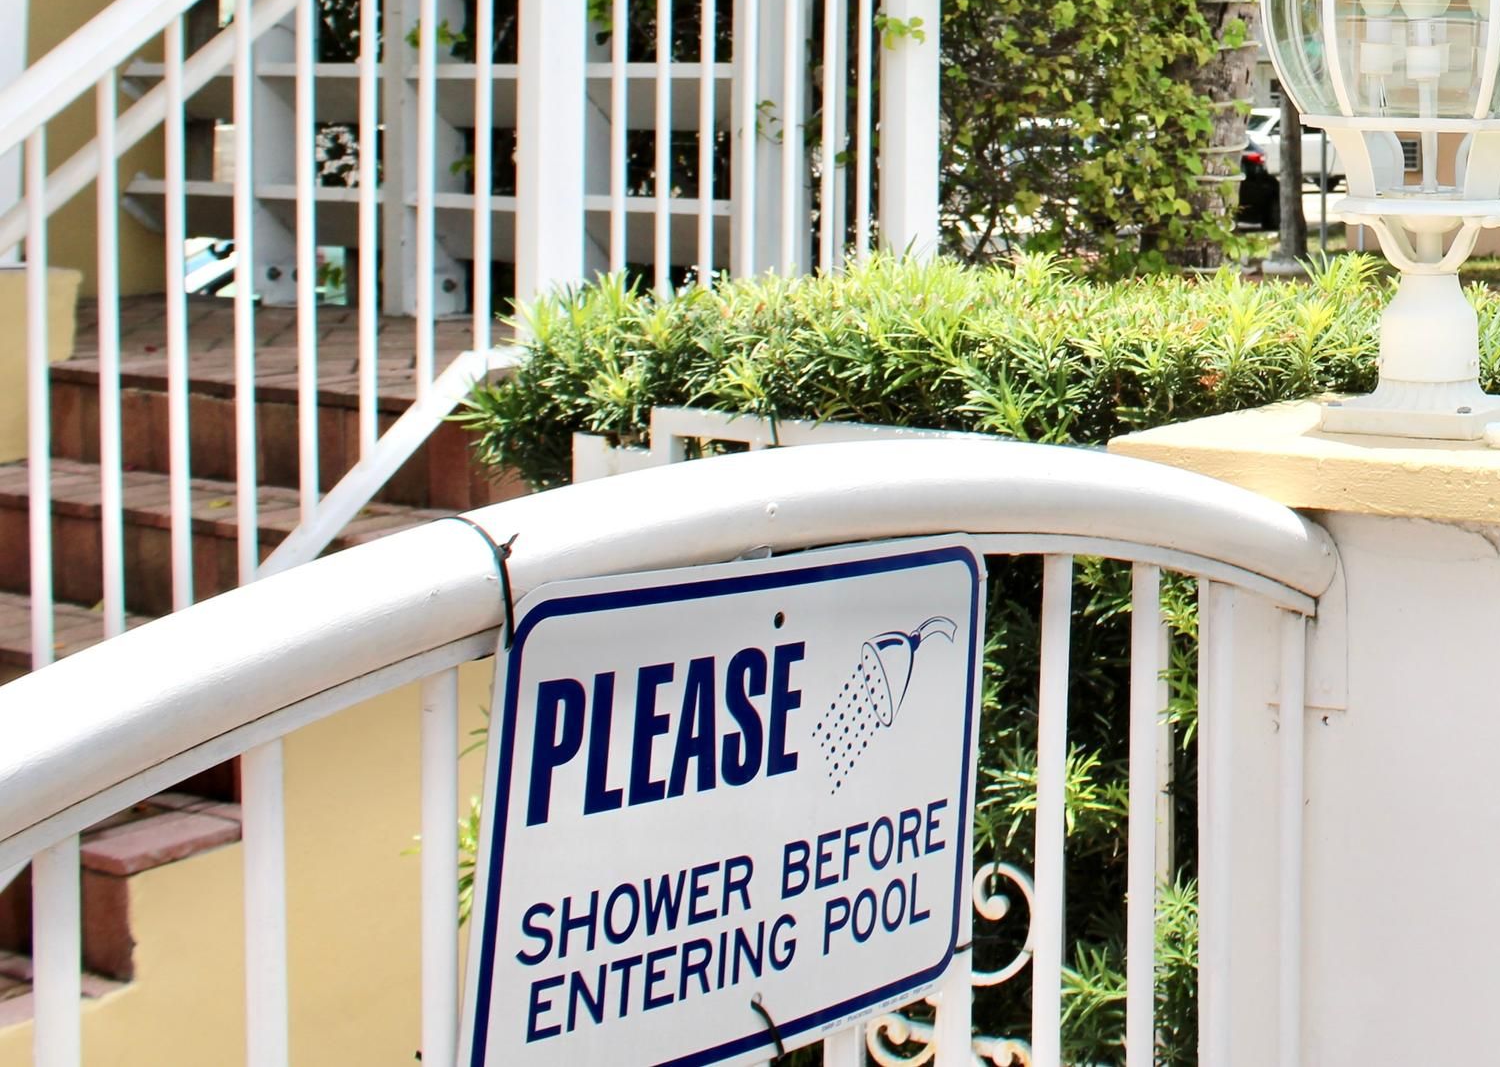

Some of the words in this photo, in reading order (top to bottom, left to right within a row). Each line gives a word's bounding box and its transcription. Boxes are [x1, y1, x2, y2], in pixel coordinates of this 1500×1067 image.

[526, 641, 806, 827] PLEASE
[515, 855, 754, 966] SHOWER
[781, 798, 948, 900] BEFORE
[526, 913, 797, 1044] ENTERING
[823, 872, 931, 956] POOL
